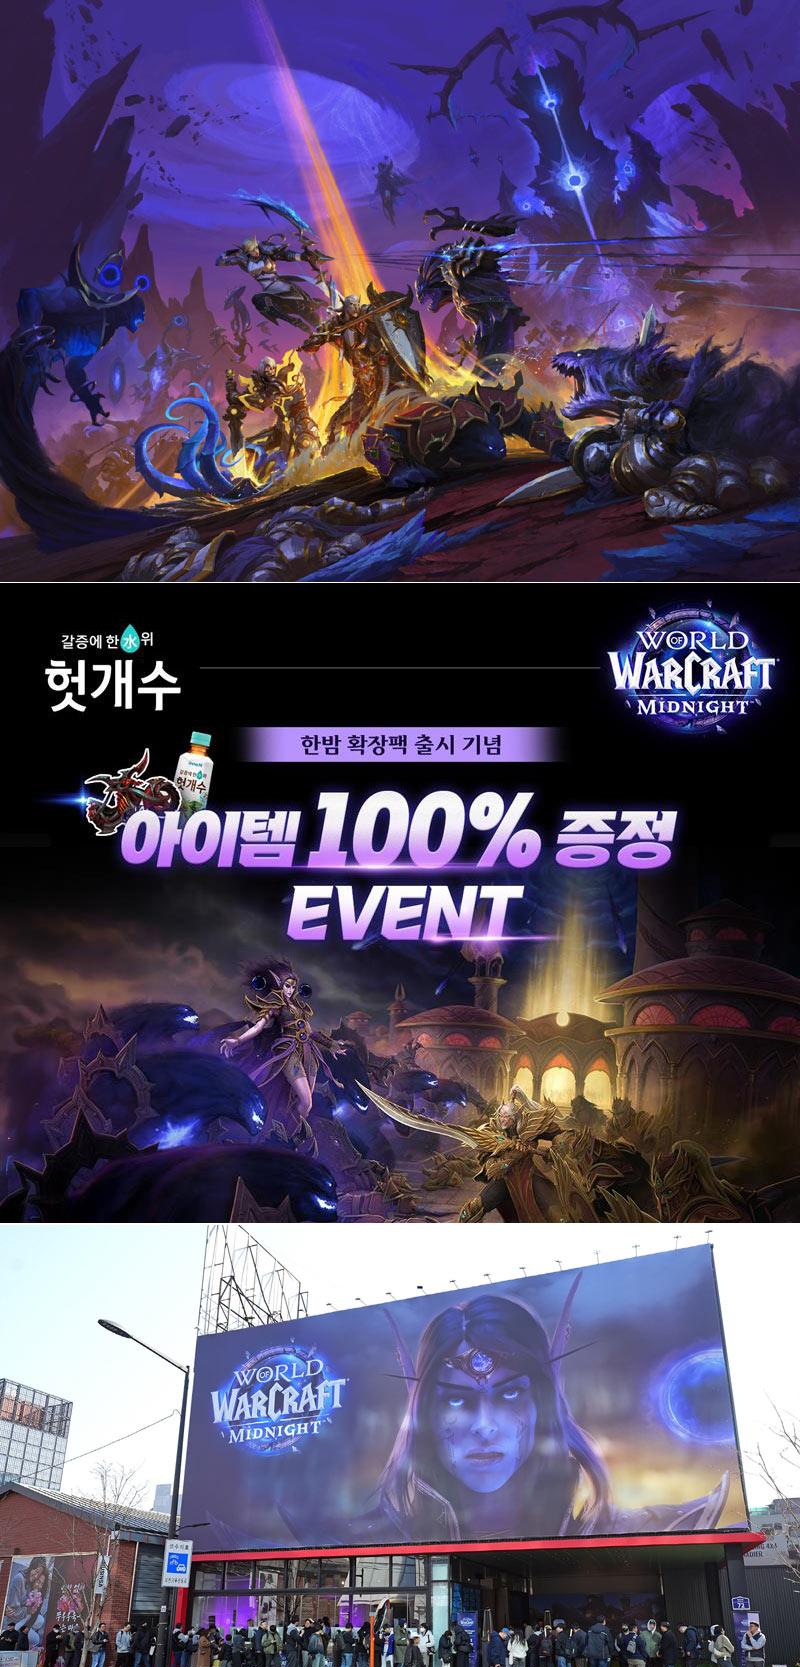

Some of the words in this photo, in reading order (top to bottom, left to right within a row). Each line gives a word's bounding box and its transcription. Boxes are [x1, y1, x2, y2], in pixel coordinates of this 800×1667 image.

[61, 634, 102, 649] 갈증에
[636, 631, 749, 653] WORLD
[670, 636, 683, 645] OF
[607, 650, 776, 696] WARCRAFT
[44, 659, 182, 712] 헛개수
[637, 697, 750, 716] MIDNIGHT
[300, 734, 342, 756] 한밤
[347, 734, 408, 756] 확장팩
[414, 734, 455, 756] 출시
[462, 734, 502, 756] 기념
[176, 776, 206, 794] 헛개수
[120, 810, 302, 868] 아이템
[307, 790, 542, 869] 100%
[554, 810, 678, 869] 증정
[286, 884, 525, 941] EVENT
[234, 1359, 324, 1386] WORLD
[259, 1371, 270, 1379] OF
[210, 1379, 346, 1423] WARCRAFT
[228, 1421, 321, 1444] MIDNIGHT
